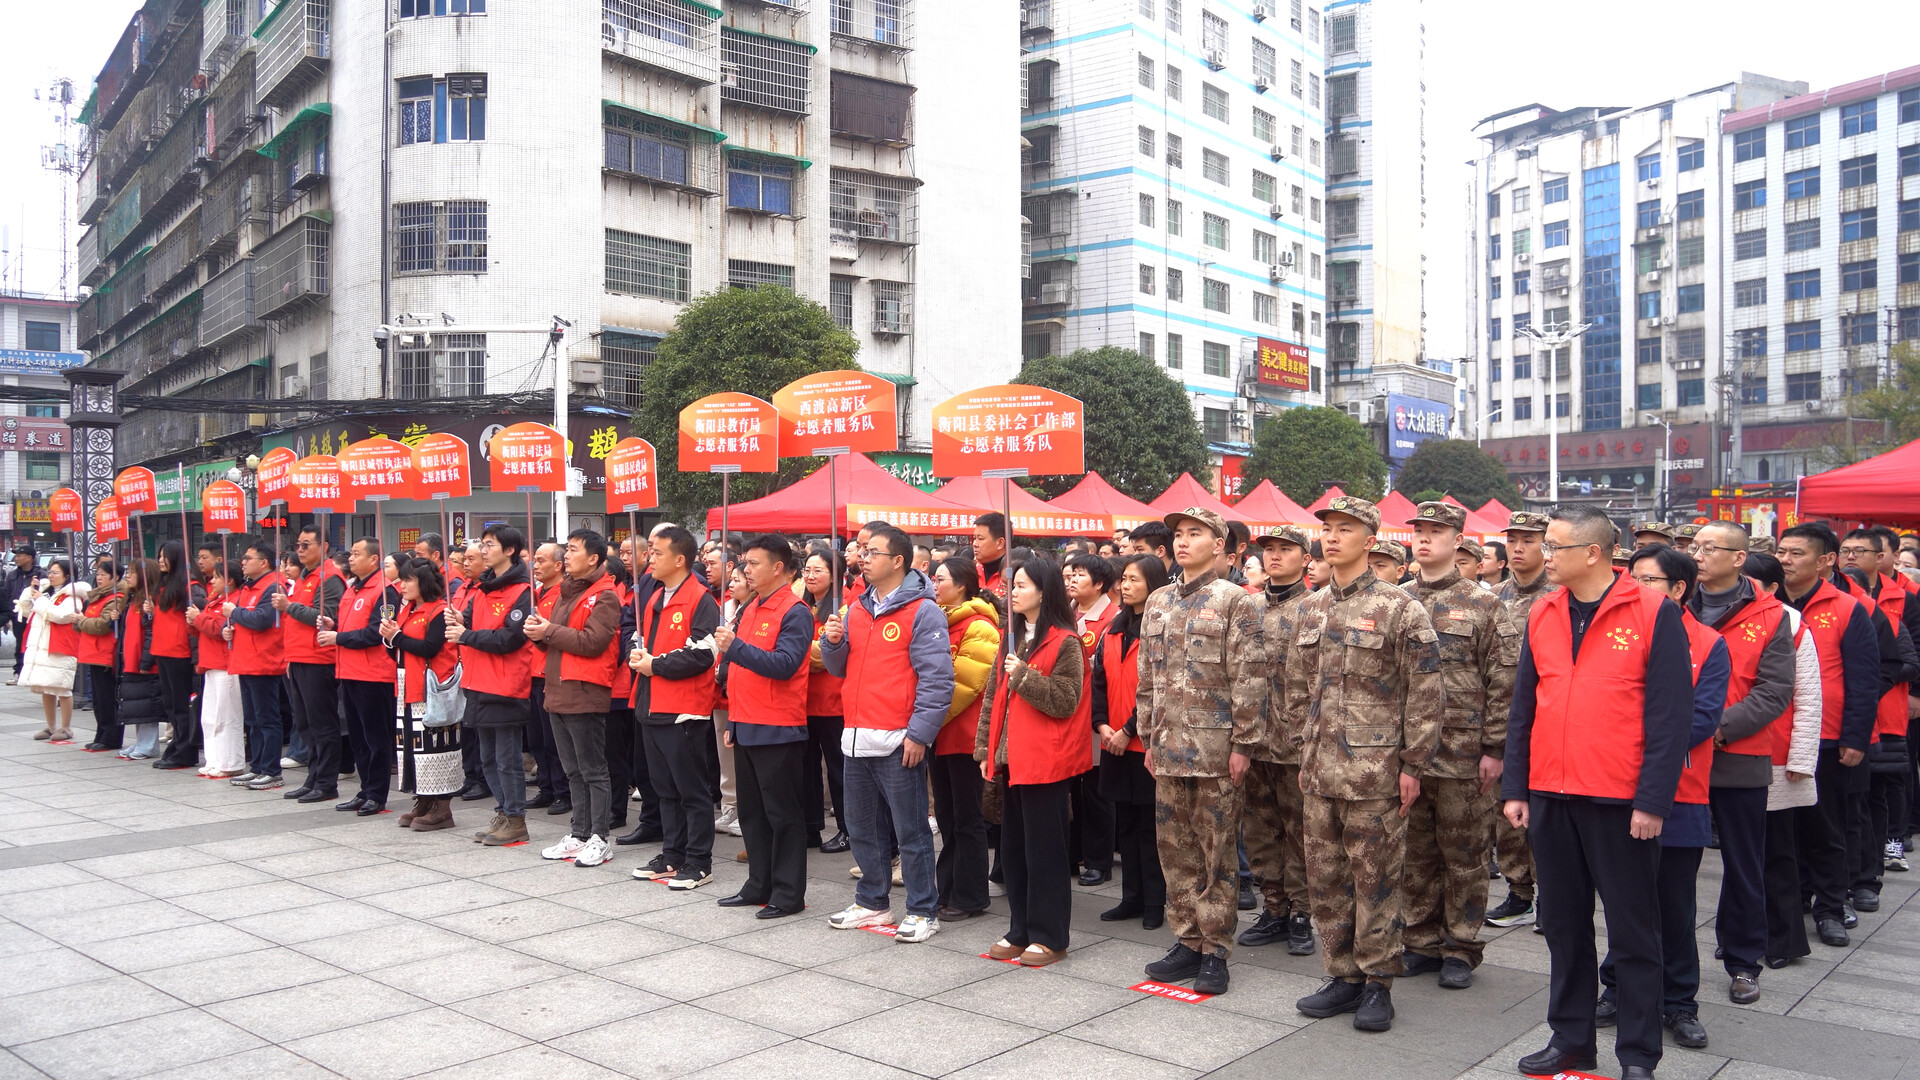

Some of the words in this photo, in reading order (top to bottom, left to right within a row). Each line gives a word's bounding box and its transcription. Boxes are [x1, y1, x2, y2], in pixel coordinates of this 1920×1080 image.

[1261, 346, 1288, 372] 美之健
[800, 395, 867, 416] 西渡高新区
[695, 417, 760, 434] 衡阳县教育局
[794, 415, 875, 436] 志愿者服务队
[938, 411, 1076, 433] 衡阳县委社会工作部
[1407, 407, 1446, 436] 大众眼镜
[2, 430, 64, 446] 跆拳道
[694, 437, 760, 453] 志愿者服务队
[960, 434, 1053, 454] 志愿者服务队
[502, 443, 552, 459] 衡阳县司法局
[341, 456, 412, 472] 衡阳县城管执法局
[420, 452, 459, 469] 衡阳县人社局
[502, 460, 553, 475] 志愿者服务队
[613, 458, 647, 478] 衡阳县民政局
[292, 472, 340, 485] 衡阳县交通运
[351, 471, 404, 486] 志愿者服务队
[422, 467, 461, 484] 志愿者服务队
[614, 476, 648, 495] 志愿者服务队
[857, 510, 982, 528] 衡阳西渡高新区志愿者服务
